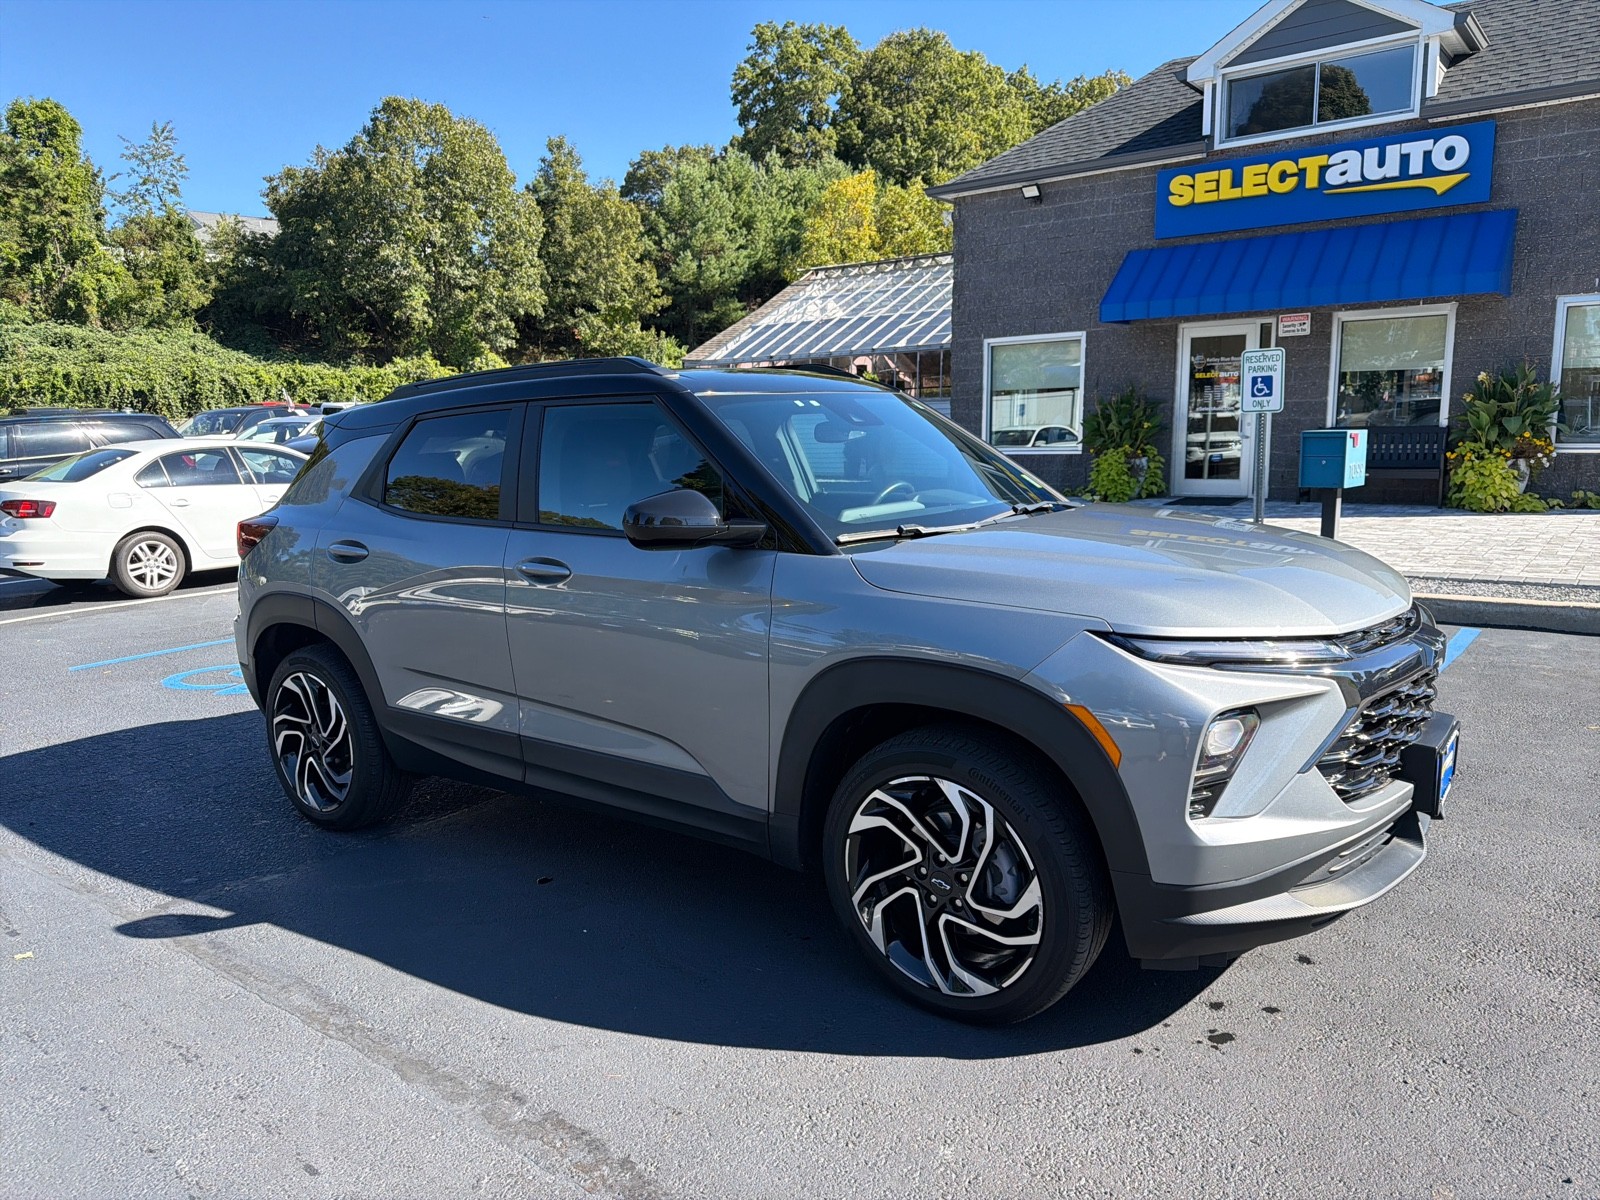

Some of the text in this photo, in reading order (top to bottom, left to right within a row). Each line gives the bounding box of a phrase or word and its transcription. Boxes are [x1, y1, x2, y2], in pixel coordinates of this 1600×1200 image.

[1245, 353, 1281, 364] RESERVED
[1248, 363, 1278, 374] PARKING
[1252, 399, 1271, 409] ONLY
[967, 767, 1026, 815] Continental
